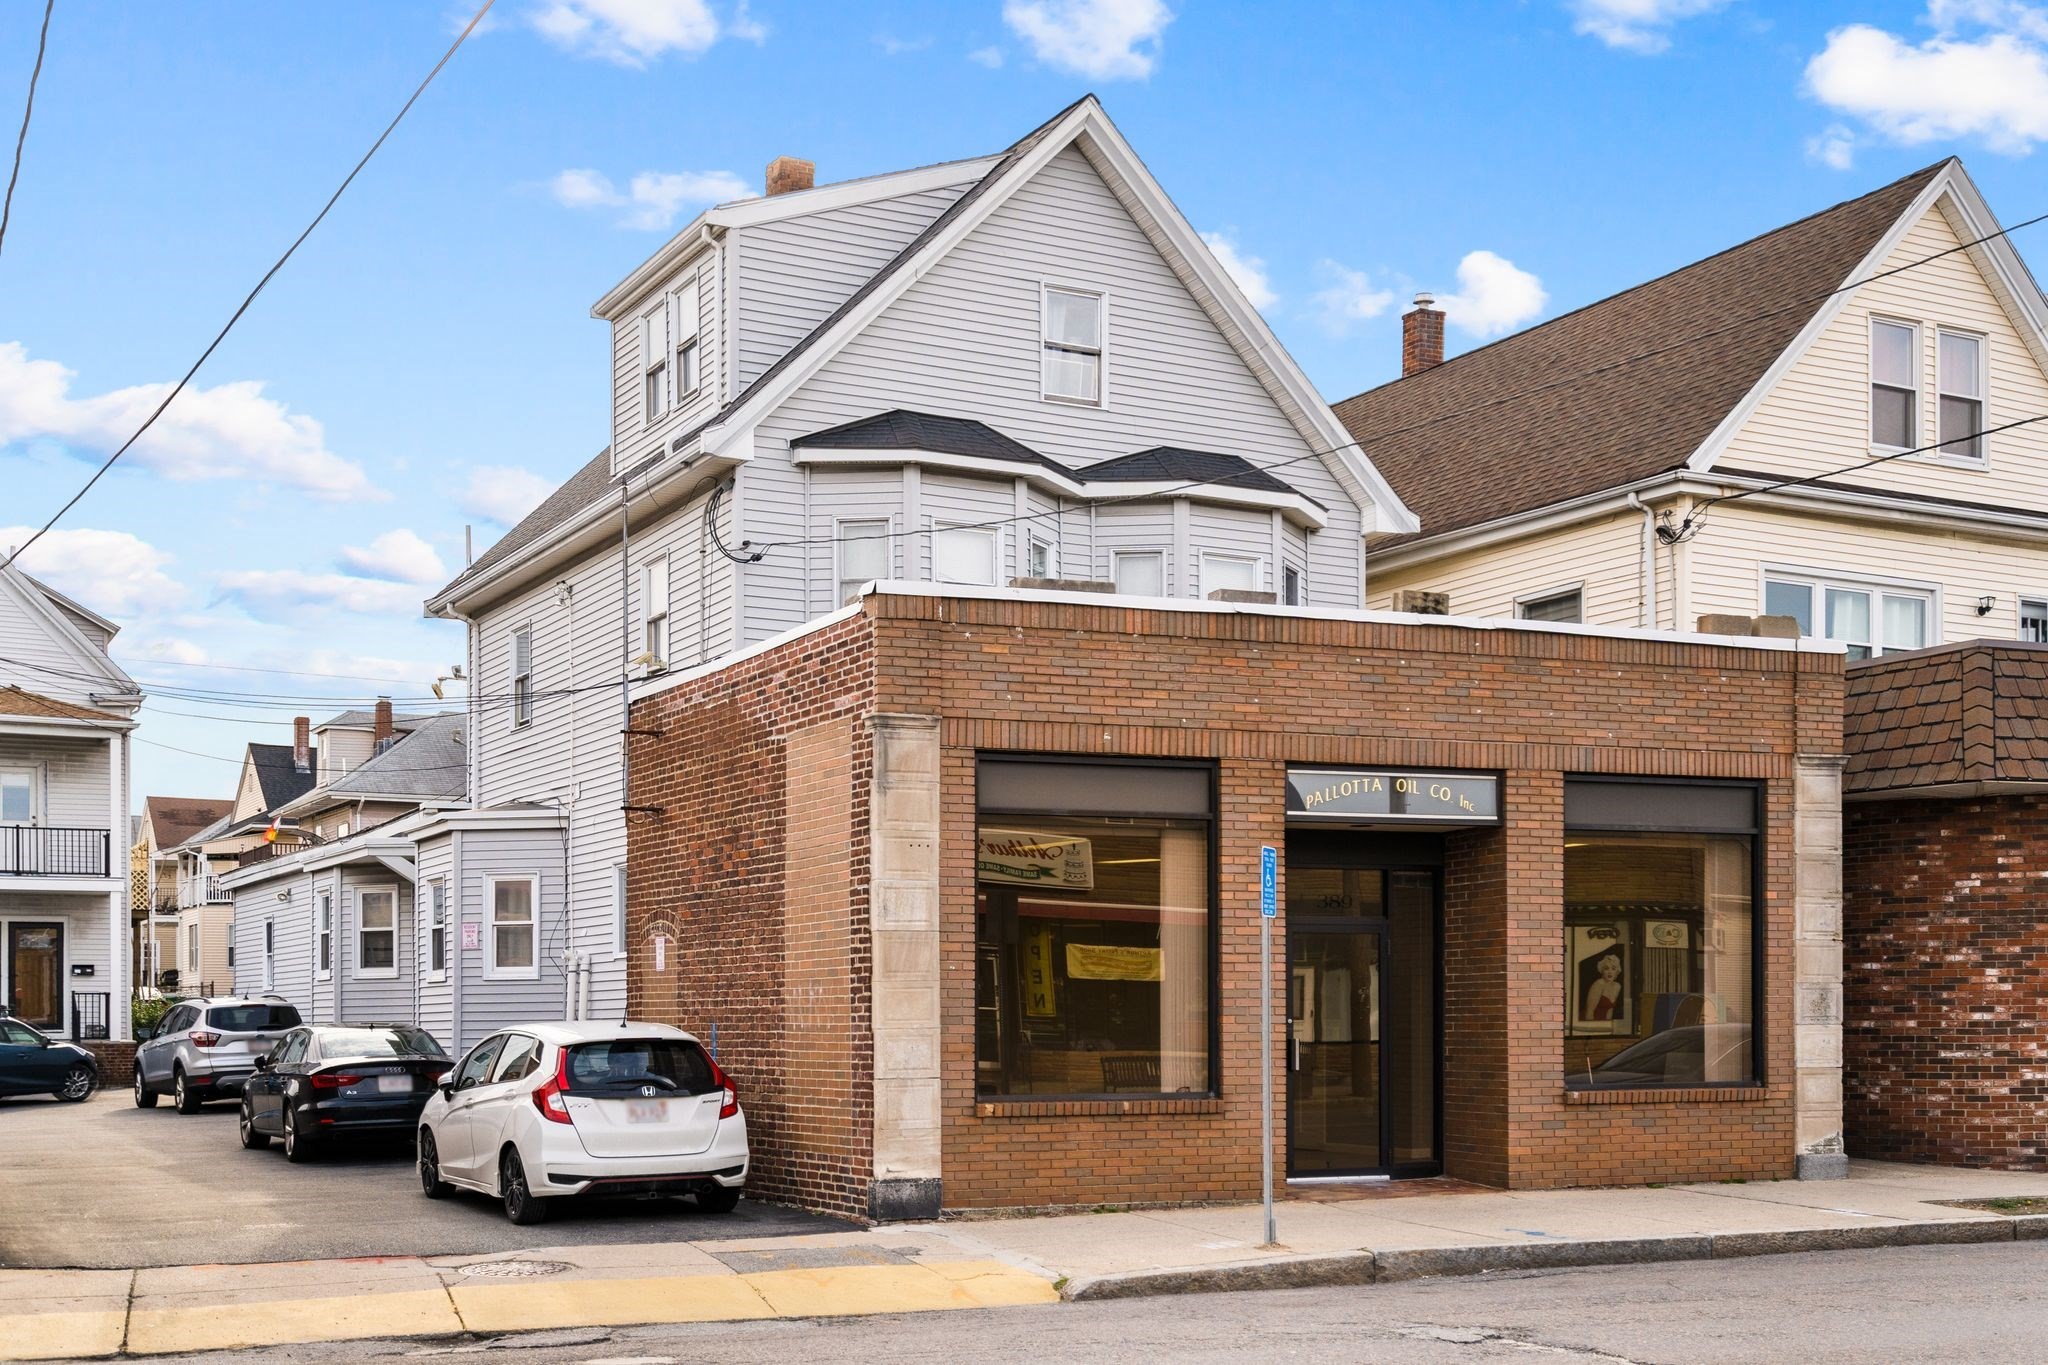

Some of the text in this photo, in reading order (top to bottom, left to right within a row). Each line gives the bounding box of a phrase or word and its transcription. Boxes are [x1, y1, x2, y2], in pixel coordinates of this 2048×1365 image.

[1305, 778, 1383, 810] PALLOTTA
[1396, 778, 1421, 795] OIL
[1430, 784, 1454, 804] CO.
[1316, 894, 1353, 909] 389
